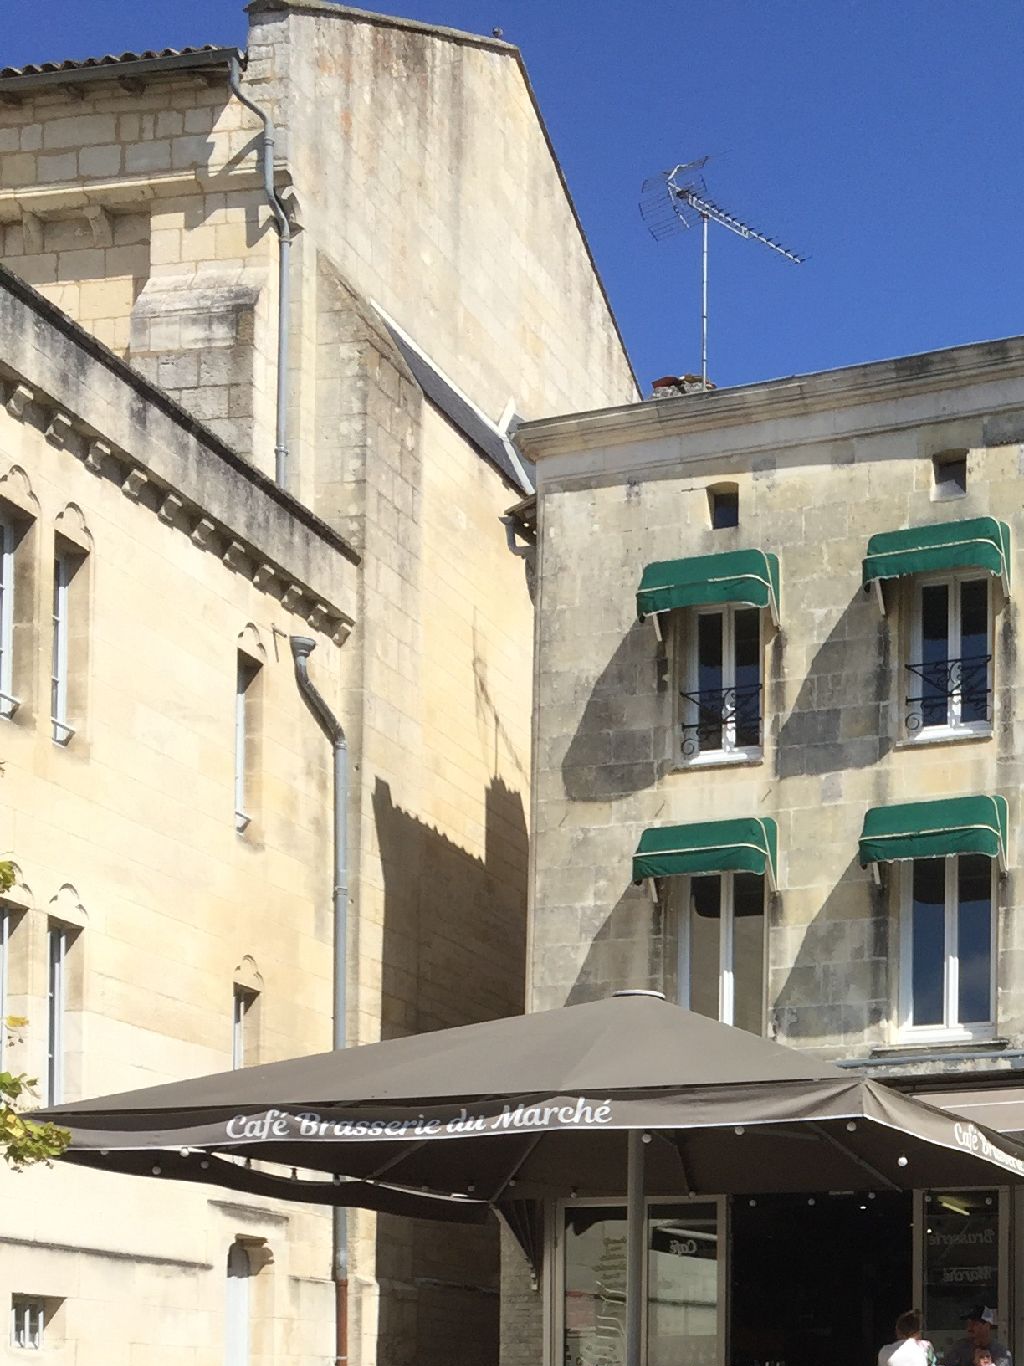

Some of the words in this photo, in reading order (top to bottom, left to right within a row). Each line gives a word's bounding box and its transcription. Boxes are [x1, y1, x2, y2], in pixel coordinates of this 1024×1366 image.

[226, 1109, 290, 1139] Café
[294, 1112, 442, 1137] Brasserie
[447, 1108, 487, 1133] du
[491, 1097, 612, 1129] Marché
[954, 1122, 979, 1152] Café
